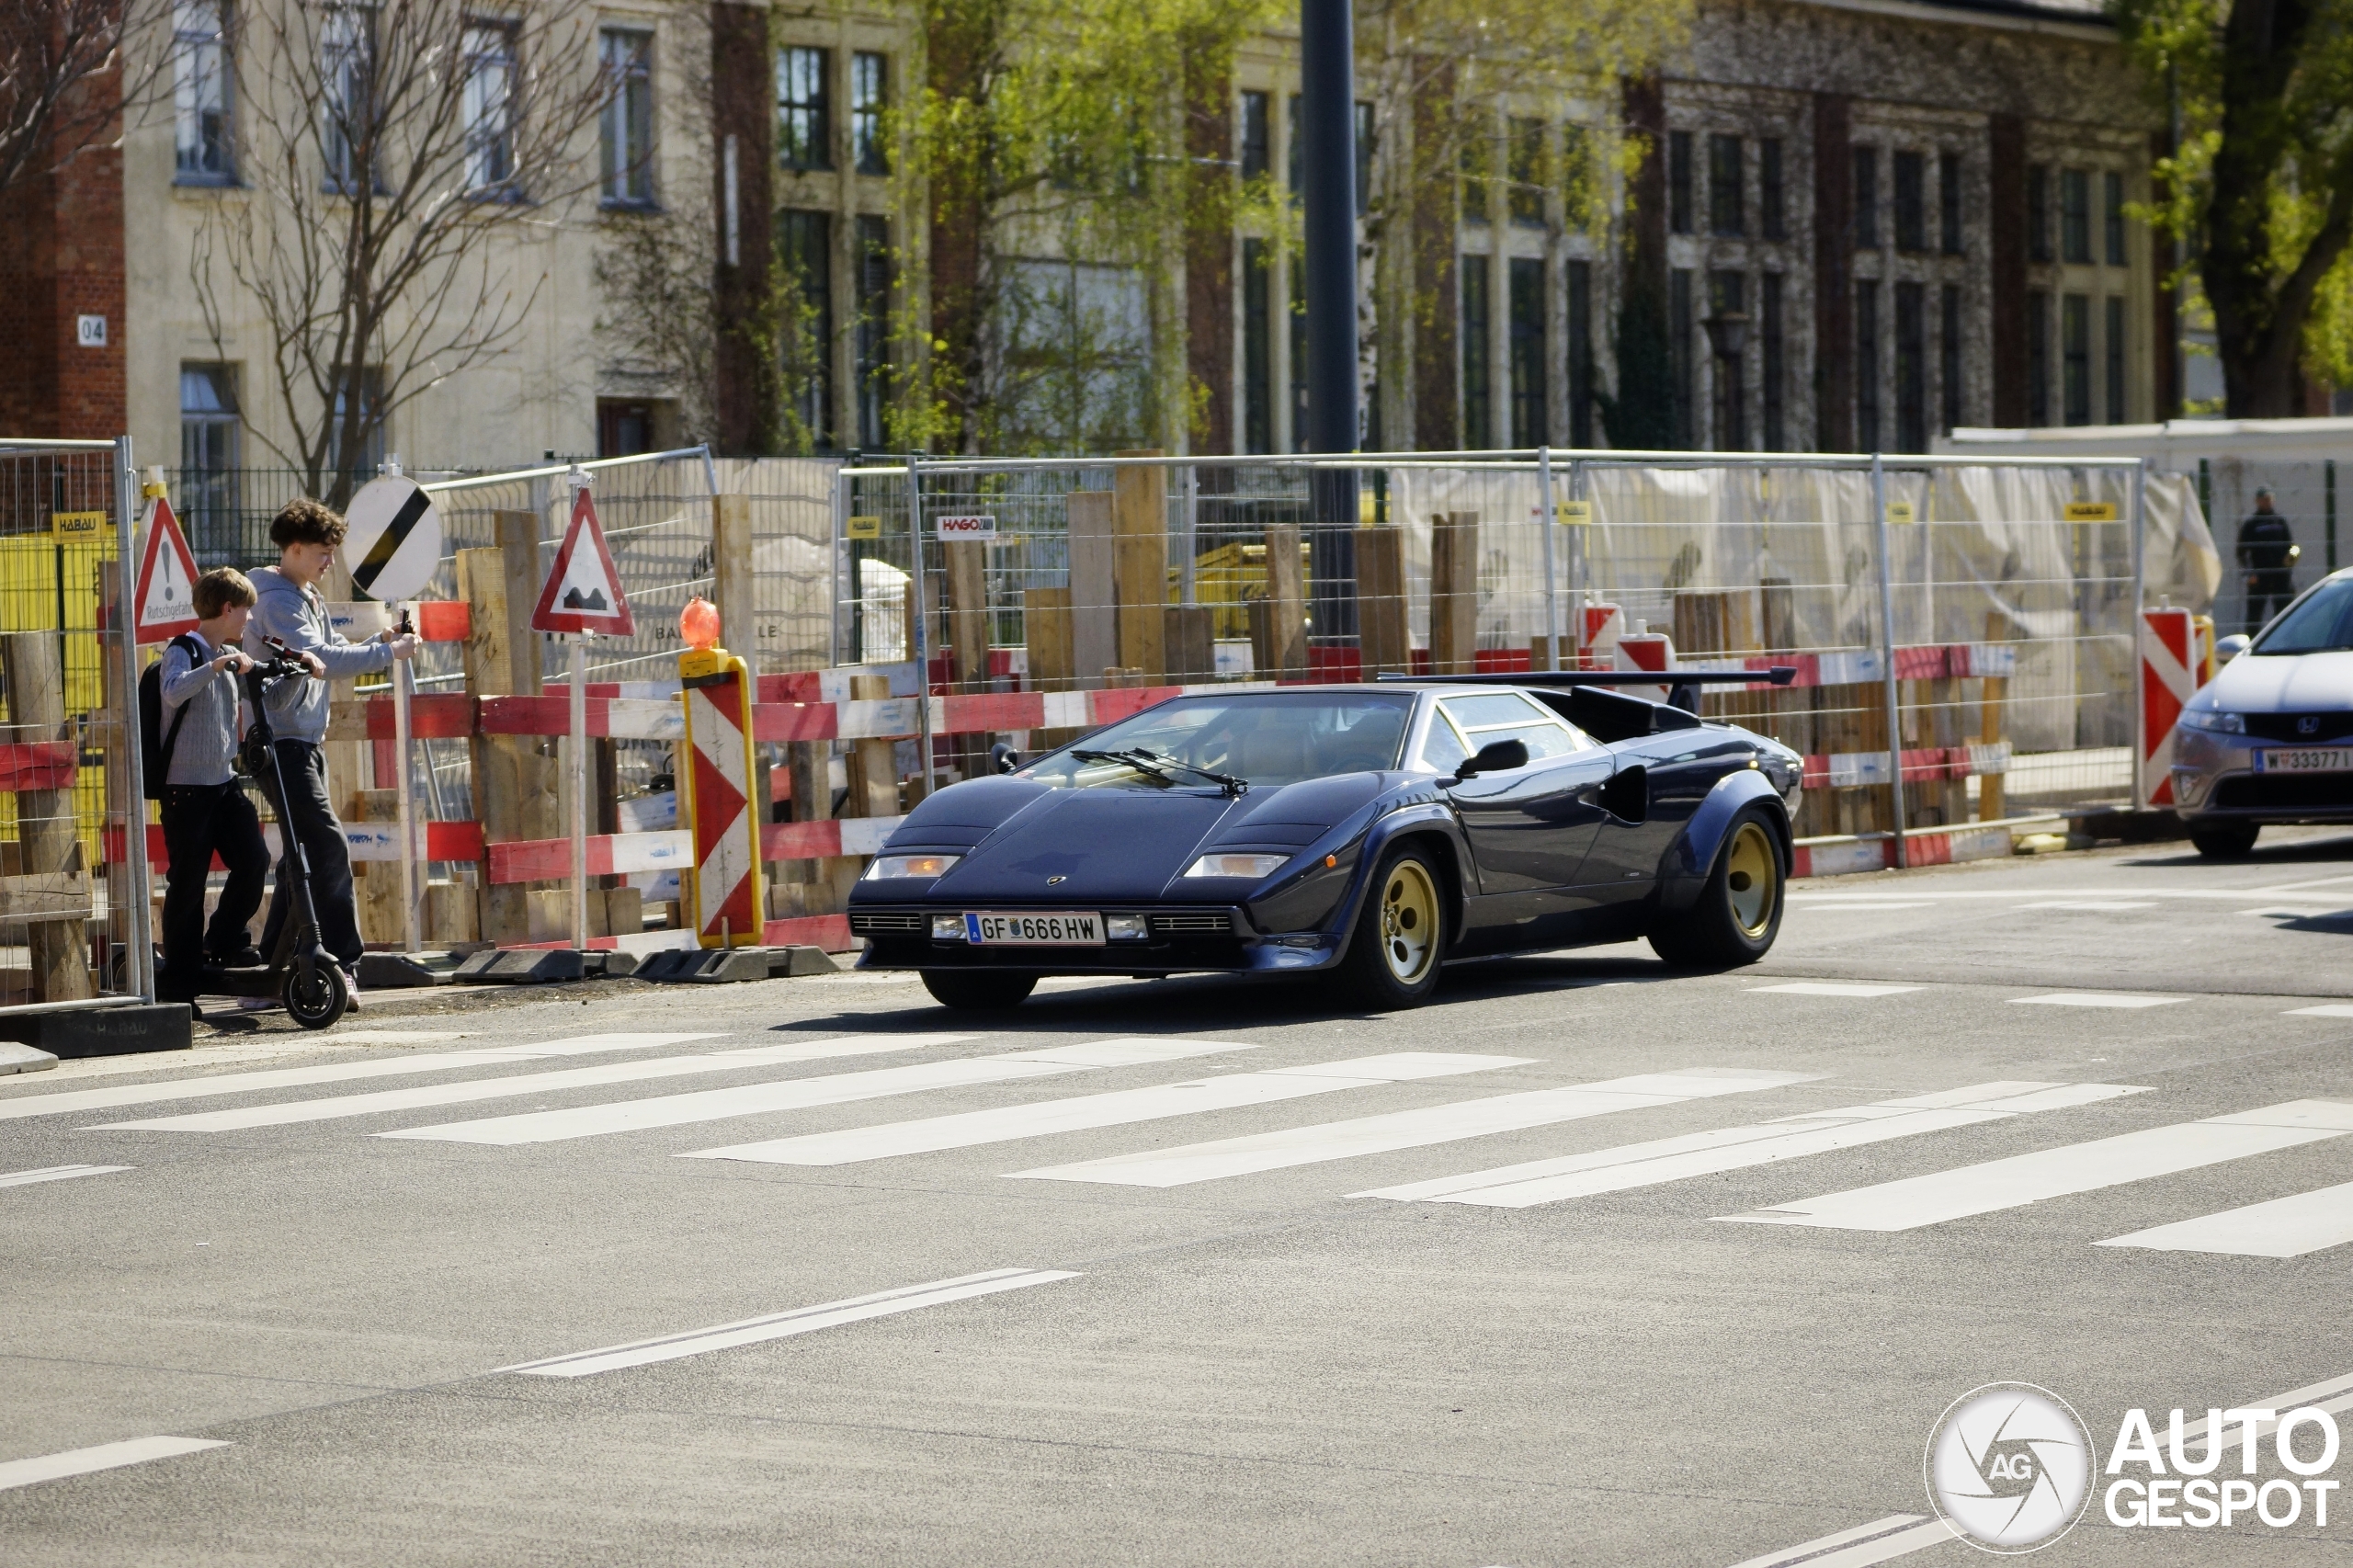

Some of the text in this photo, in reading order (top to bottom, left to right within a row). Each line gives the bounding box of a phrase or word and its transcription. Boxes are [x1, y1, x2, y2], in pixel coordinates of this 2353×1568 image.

[82, 319, 104, 340] 04
[60, 517, 97, 532] HABAU
[147, 600, 193, 619] Rutschgefahr
[2267, 753, 2279, 769] W
[2290, 751, 2339, 769] 33377
[982, 917, 1095, 940] GF 666 HW
